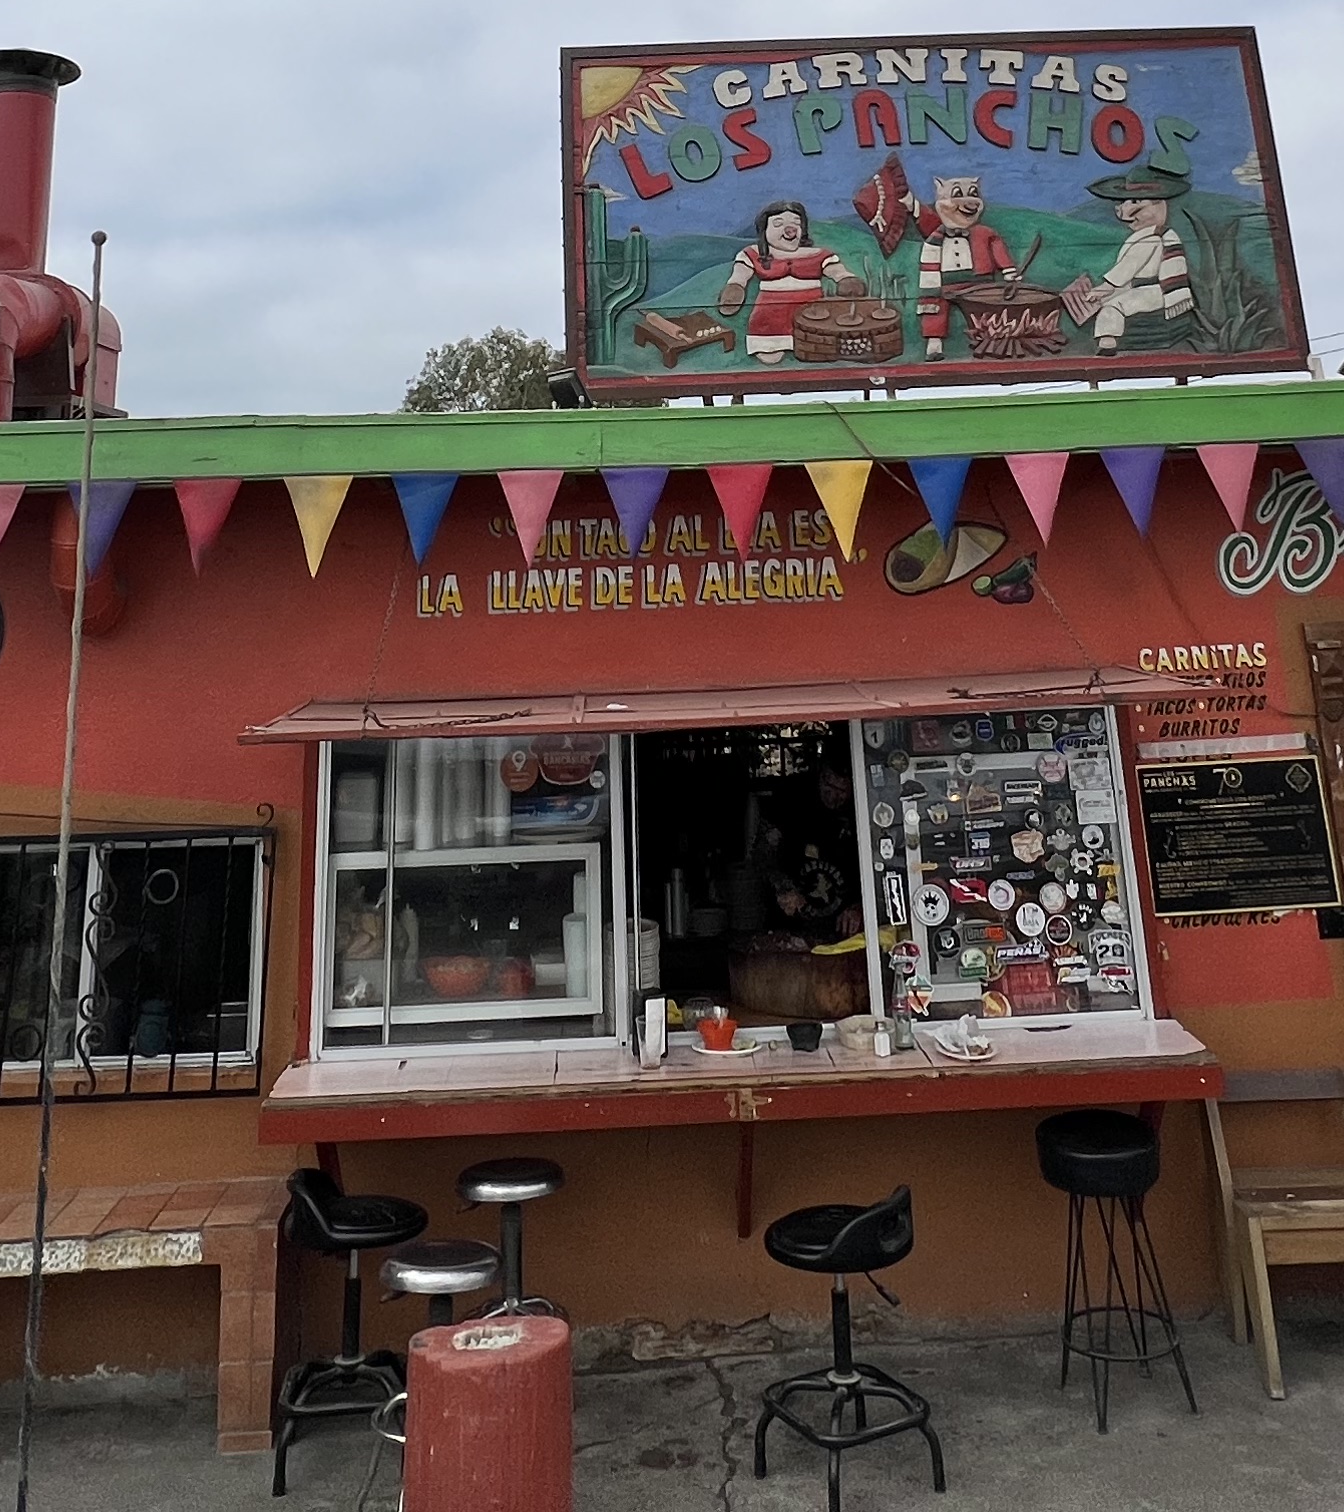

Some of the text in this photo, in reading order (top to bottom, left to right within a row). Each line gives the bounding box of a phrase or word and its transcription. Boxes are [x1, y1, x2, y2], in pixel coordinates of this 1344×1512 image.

[712, 46, 1128, 109] CARNITAS
[618, 87, 1200, 201] LOS PANCHOS
[663, 513, 710, 556] AL
[718, 510, 783, 558] DA
[790, 508, 833, 555] ES
[417, 573, 464, 618] LA
[487, 565, 584, 615] LLAVE
[590, 564, 634, 613] DE
[640, 562, 687, 609] LA
[1139, 642, 1268, 672] CARNITAS
[1220, 670, 1267, 689] KILOS
[1147, 694, 1268, 716] TACOS TORTAS
[1159, 718, 1241, 738] BURRITOS
